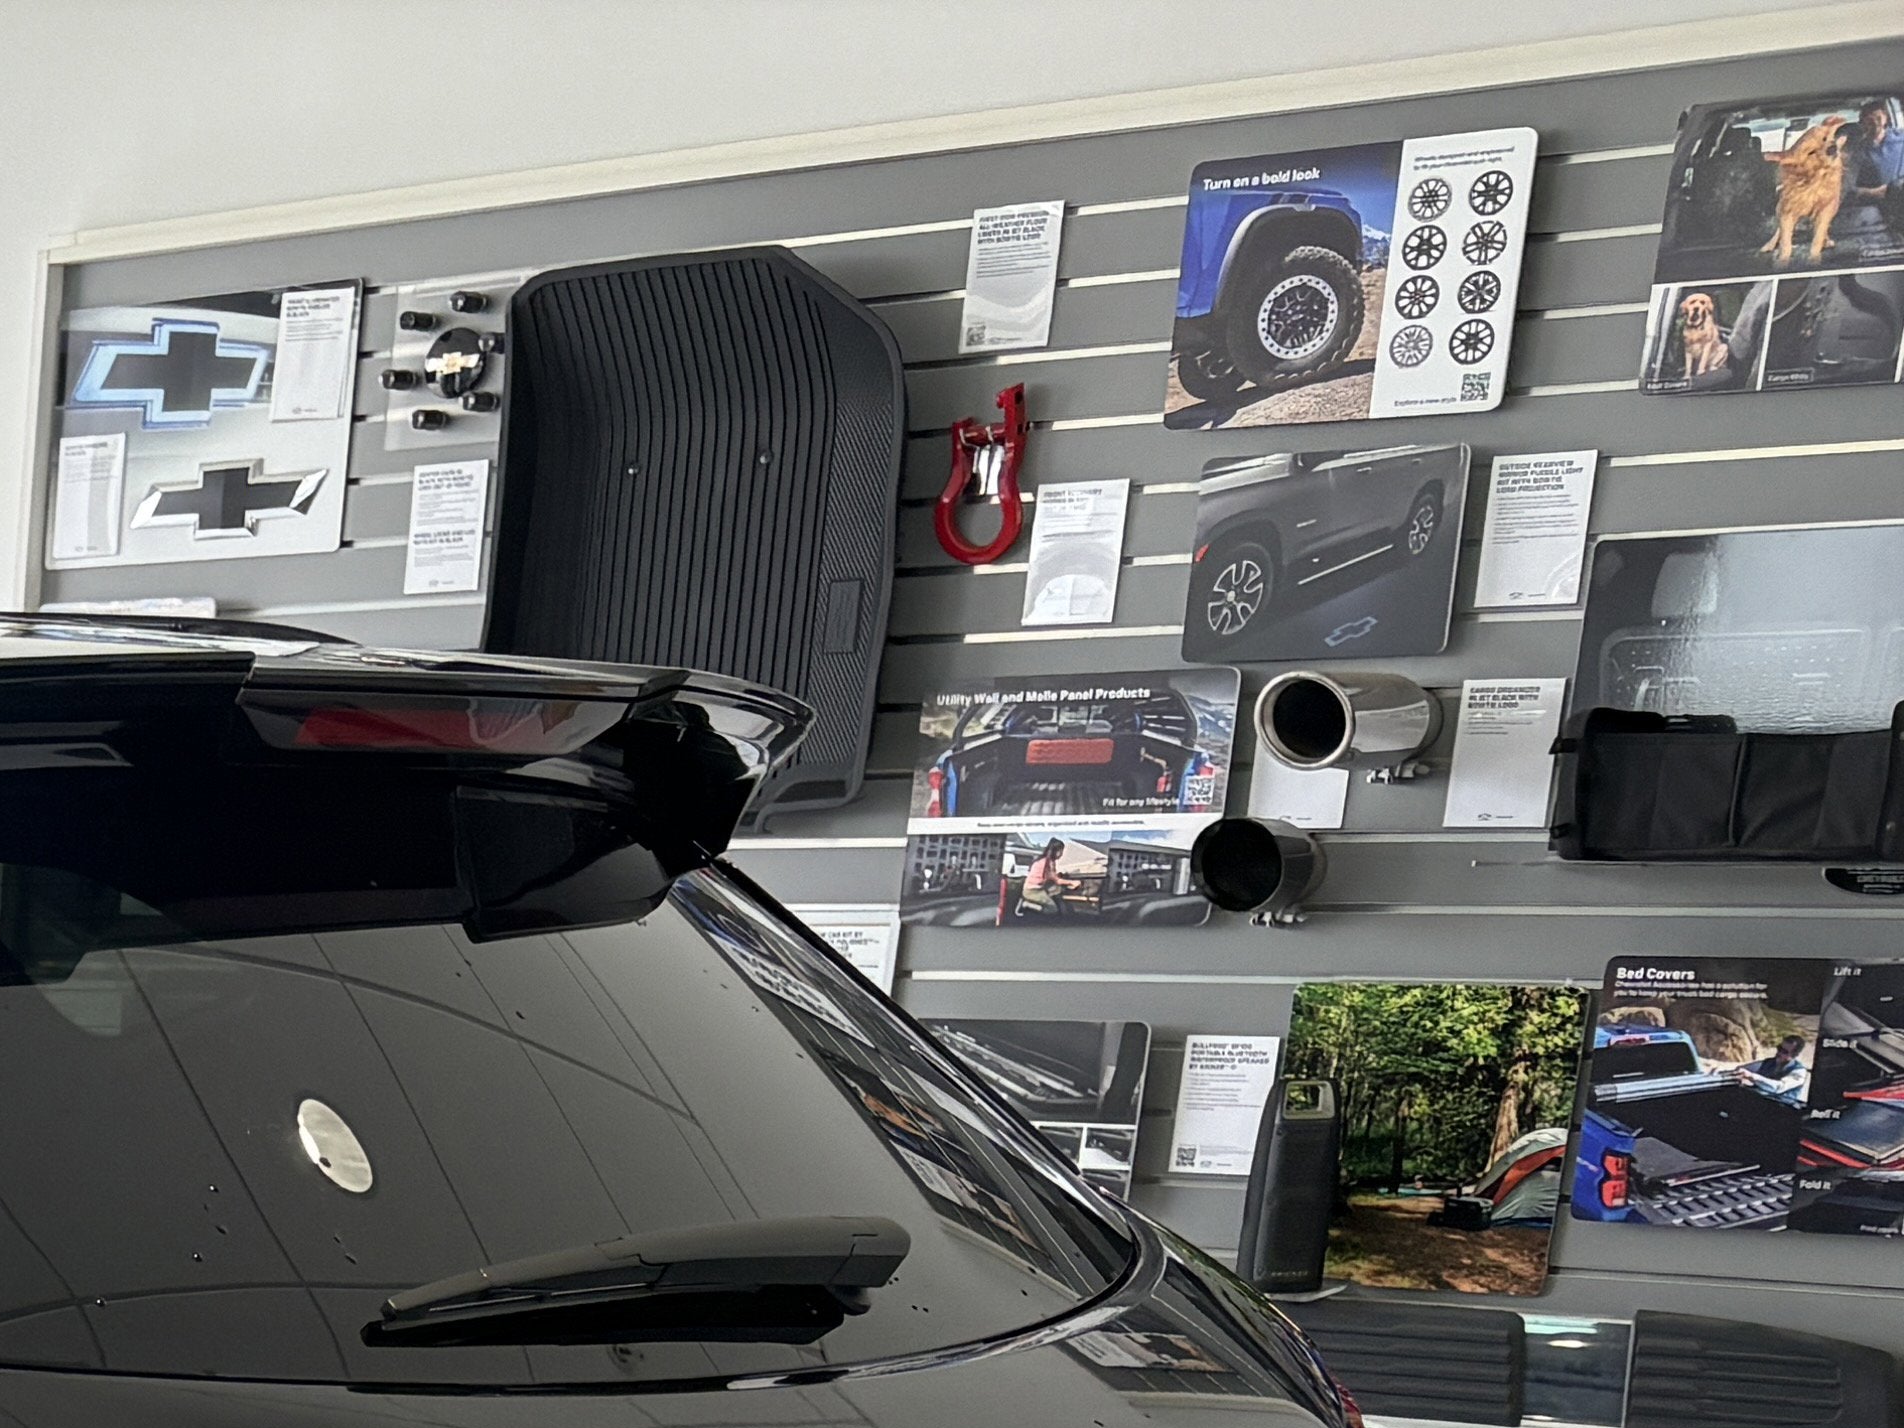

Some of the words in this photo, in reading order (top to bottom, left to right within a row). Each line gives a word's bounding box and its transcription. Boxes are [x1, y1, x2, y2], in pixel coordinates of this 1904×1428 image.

[1203, 179, 1231, 191] Turn
[1233, 176, 1249, 188] on
[1251, 176, 1260, 186] a
[1261, 171, 1291, 185] bold
[1292, 167, 1320, 181] look
[936, 694, 971, 706] Utility
[973, 692, 1000, 704] Wall
[1002, 691, 1024, 702] and
[1059, 688, 1093, 701] Panel
[1094, 687, 1151, 699] Products
[1102, 797, 1115, 807] Fit
[1116, 797, 1129, 807] for
[1129, 798, 1145, 808] any
[1616, 967, 1645, 979] Bed
[1646, 967, 1695, 980] Covers
[1833, 966, 1852, 976] Lift
[1852, 967, 1862, 976] it
[1799, 1179, 1822, 1189] Fold
[1822, 1181, 1831, 1190] it
